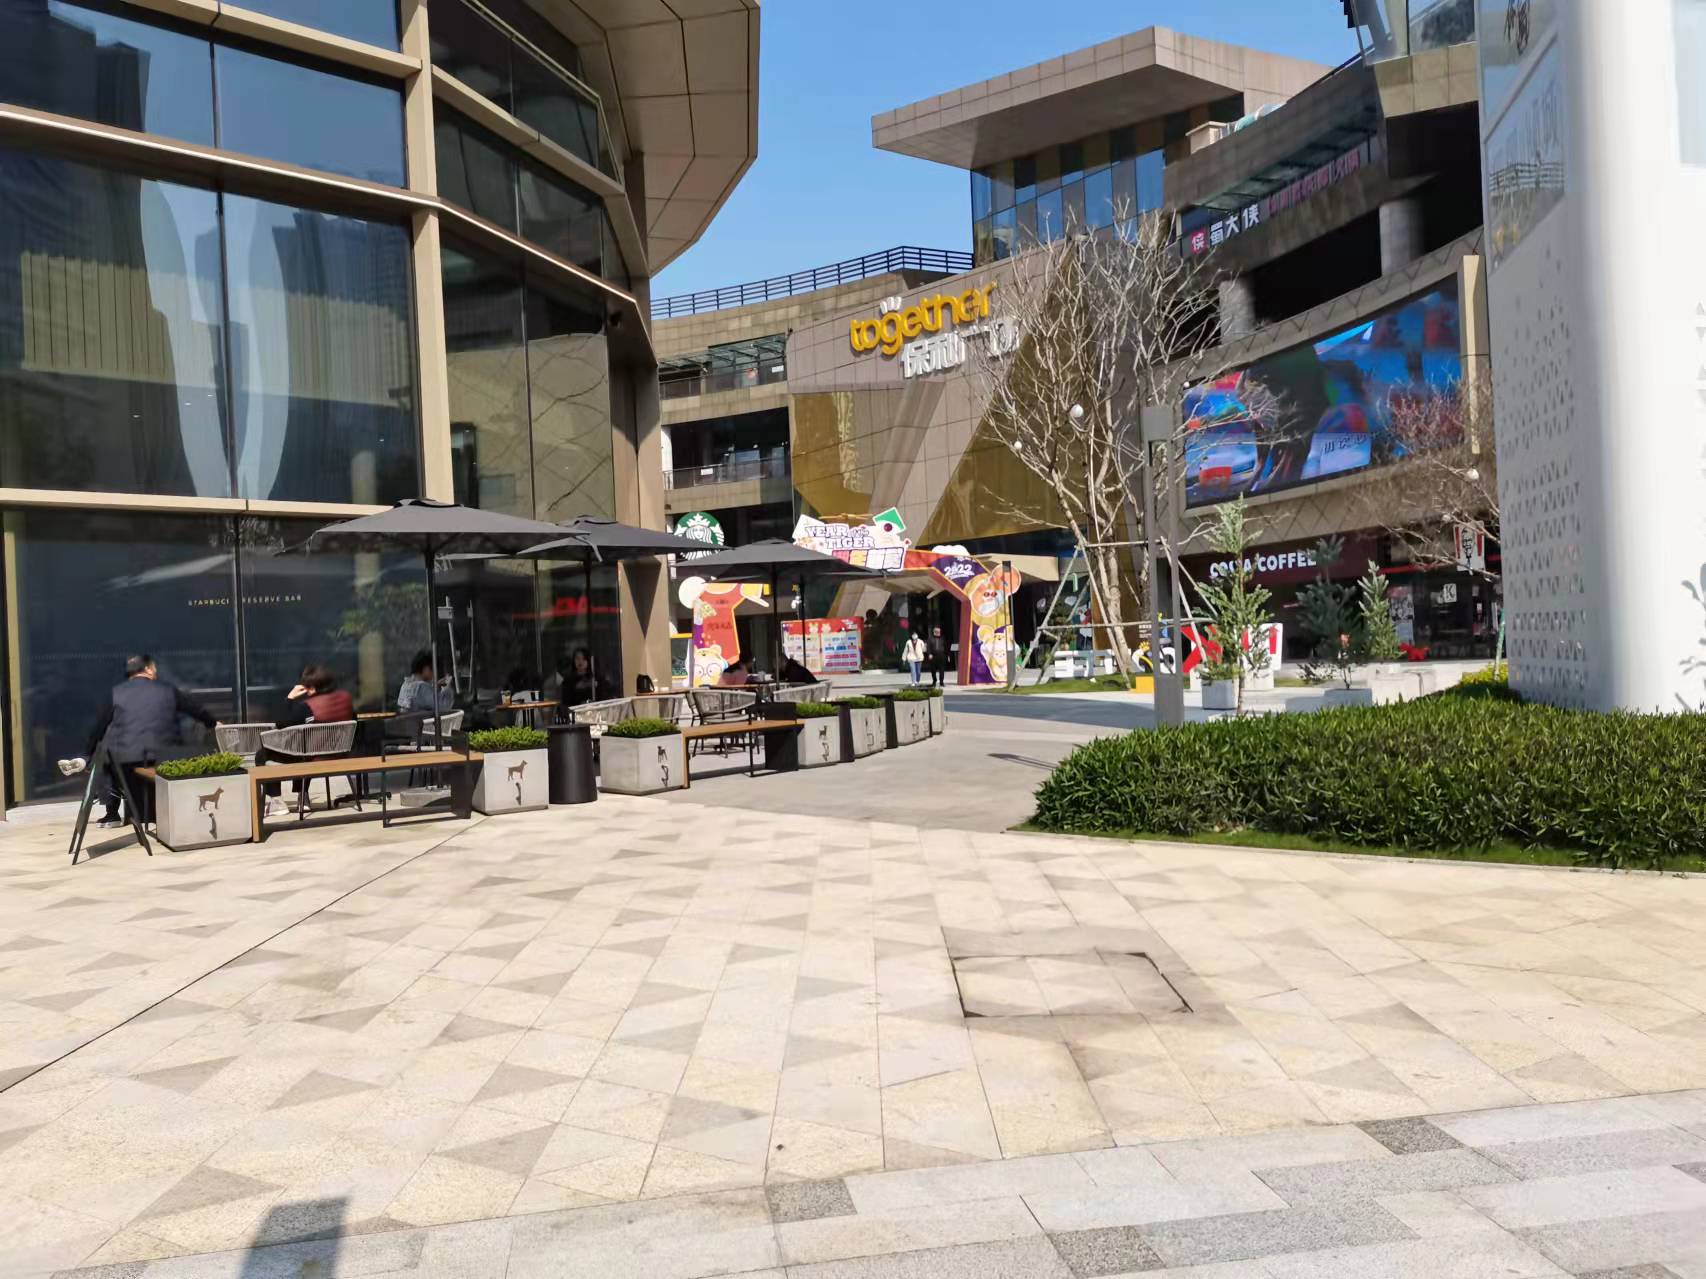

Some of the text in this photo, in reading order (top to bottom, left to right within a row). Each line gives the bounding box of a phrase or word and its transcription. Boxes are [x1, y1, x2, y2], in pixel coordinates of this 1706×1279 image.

[850, 280, 997, 355] together
[805, 525, 849, 538] YEAR
[827, 537, 875, 550] TIGER
[1257, 551, 1317, 572] COFFEE
